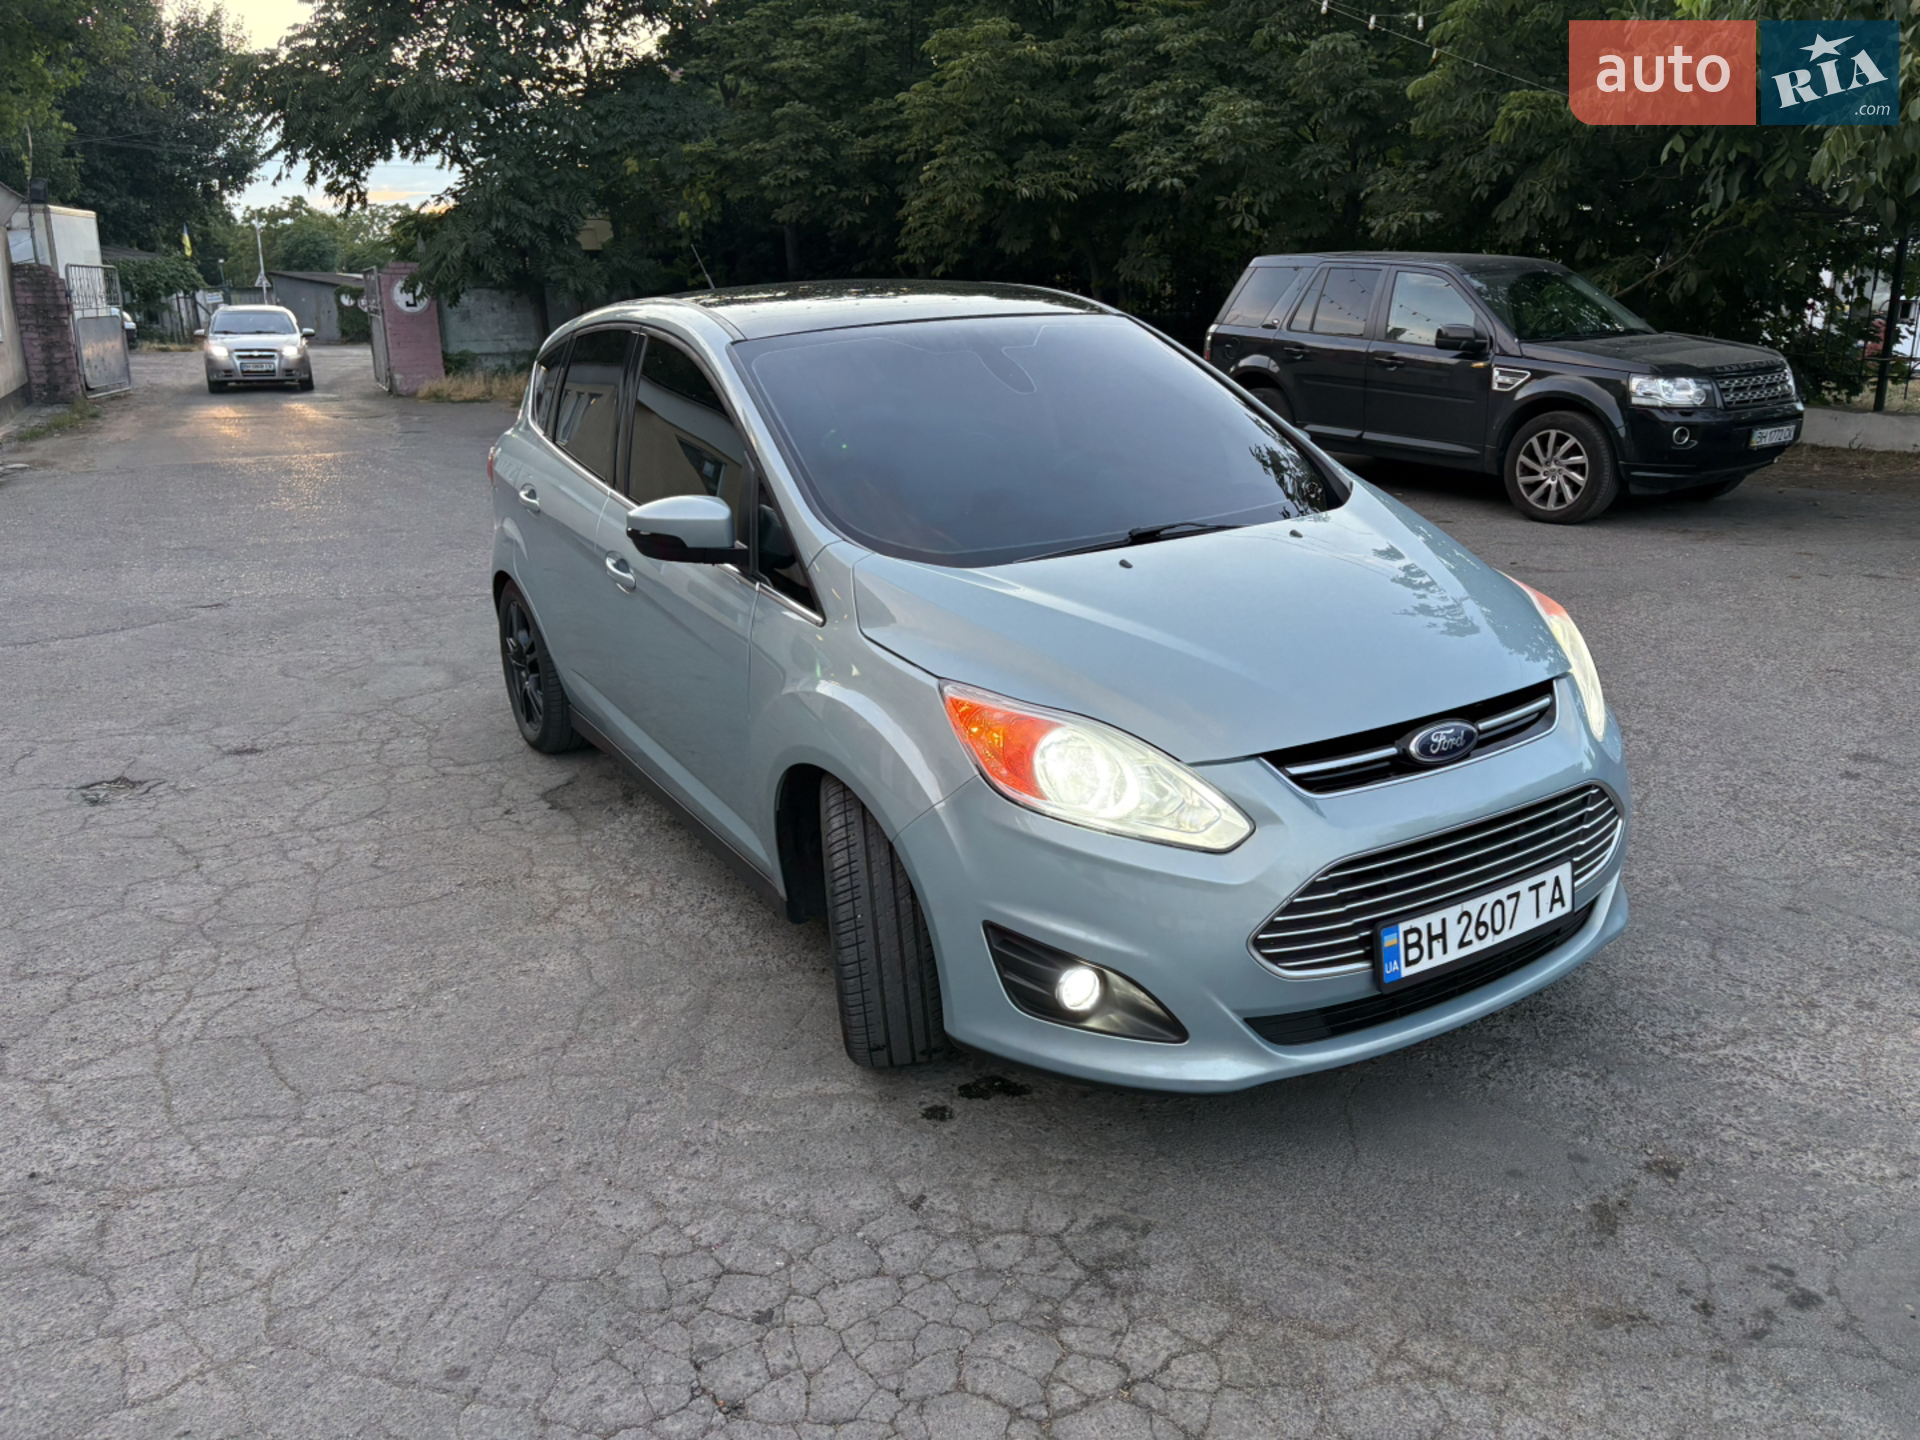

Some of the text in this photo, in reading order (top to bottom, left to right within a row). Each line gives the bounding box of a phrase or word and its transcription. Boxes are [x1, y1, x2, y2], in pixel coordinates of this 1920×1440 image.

[1429, 727, 1466, 755] Ford
[1403, 875, 1566, 968] BH 2607 TA
[1384, 959, 1400, 975] UA
